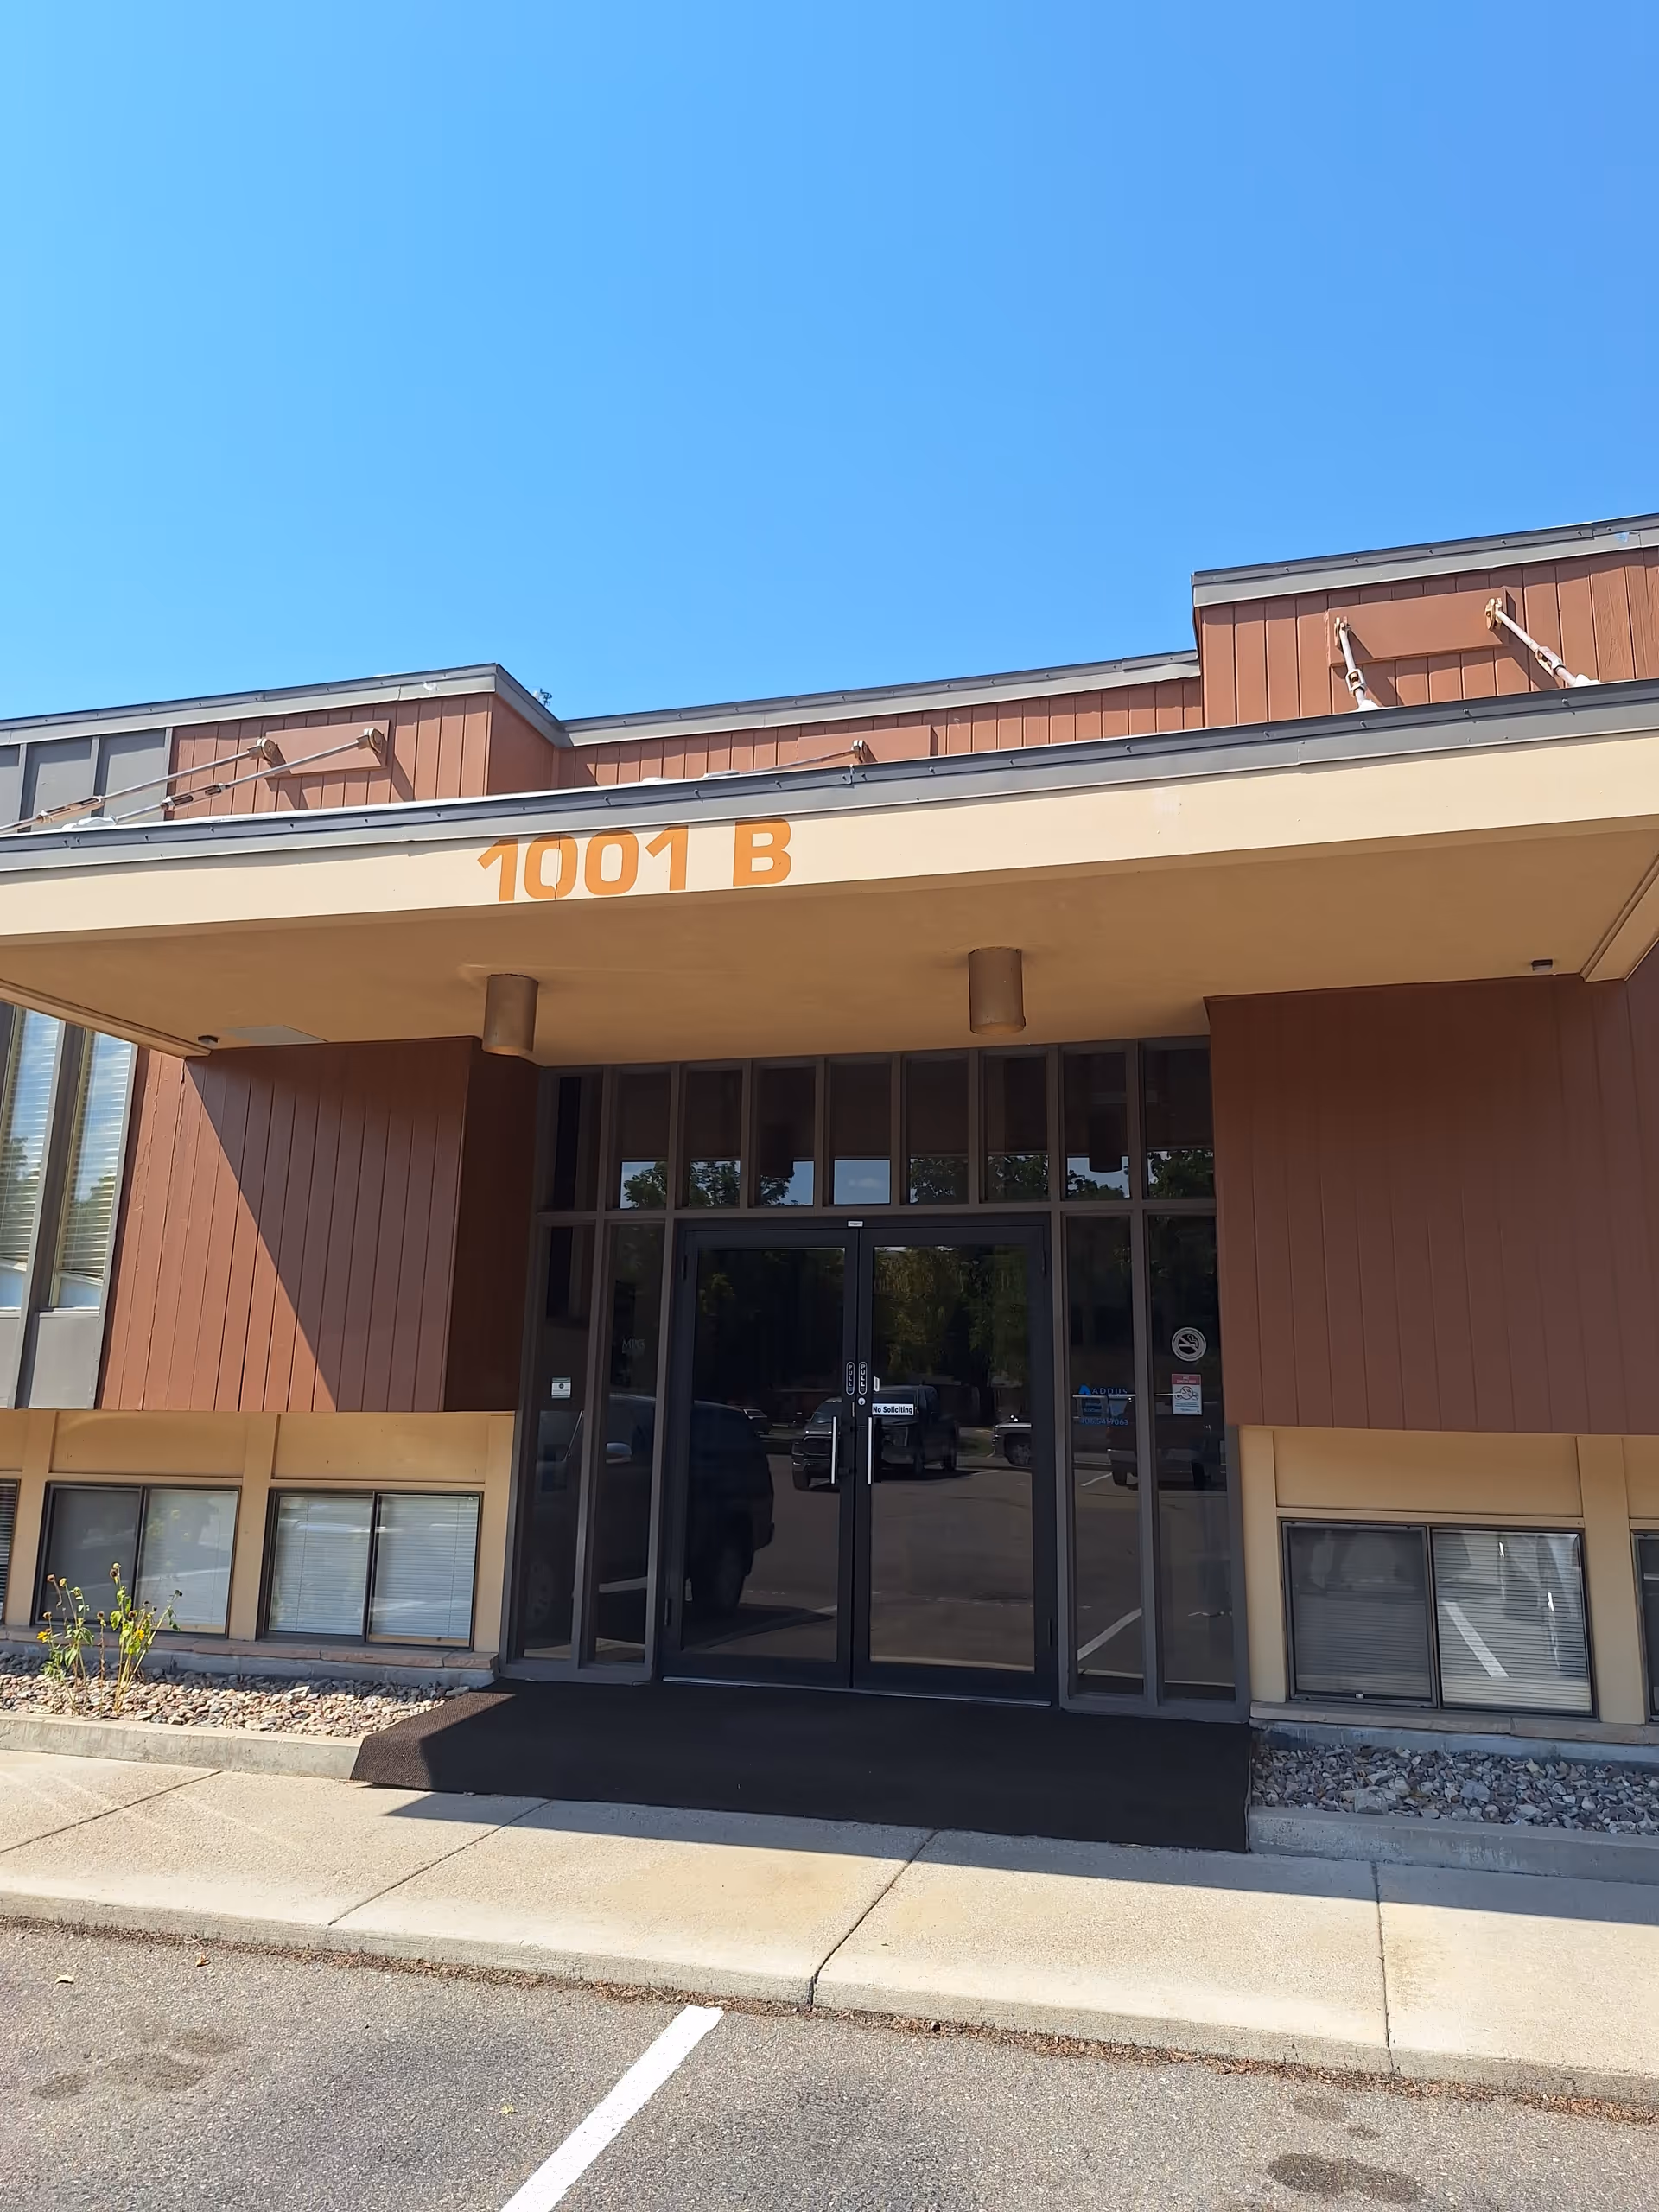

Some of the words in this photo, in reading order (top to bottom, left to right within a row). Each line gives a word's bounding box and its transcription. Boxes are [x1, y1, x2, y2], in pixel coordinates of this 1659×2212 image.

[477, 824, 690, 902] 1001
[733, 817, 792, 887] B
[883, 1406, 912, 1414] Soliciting
